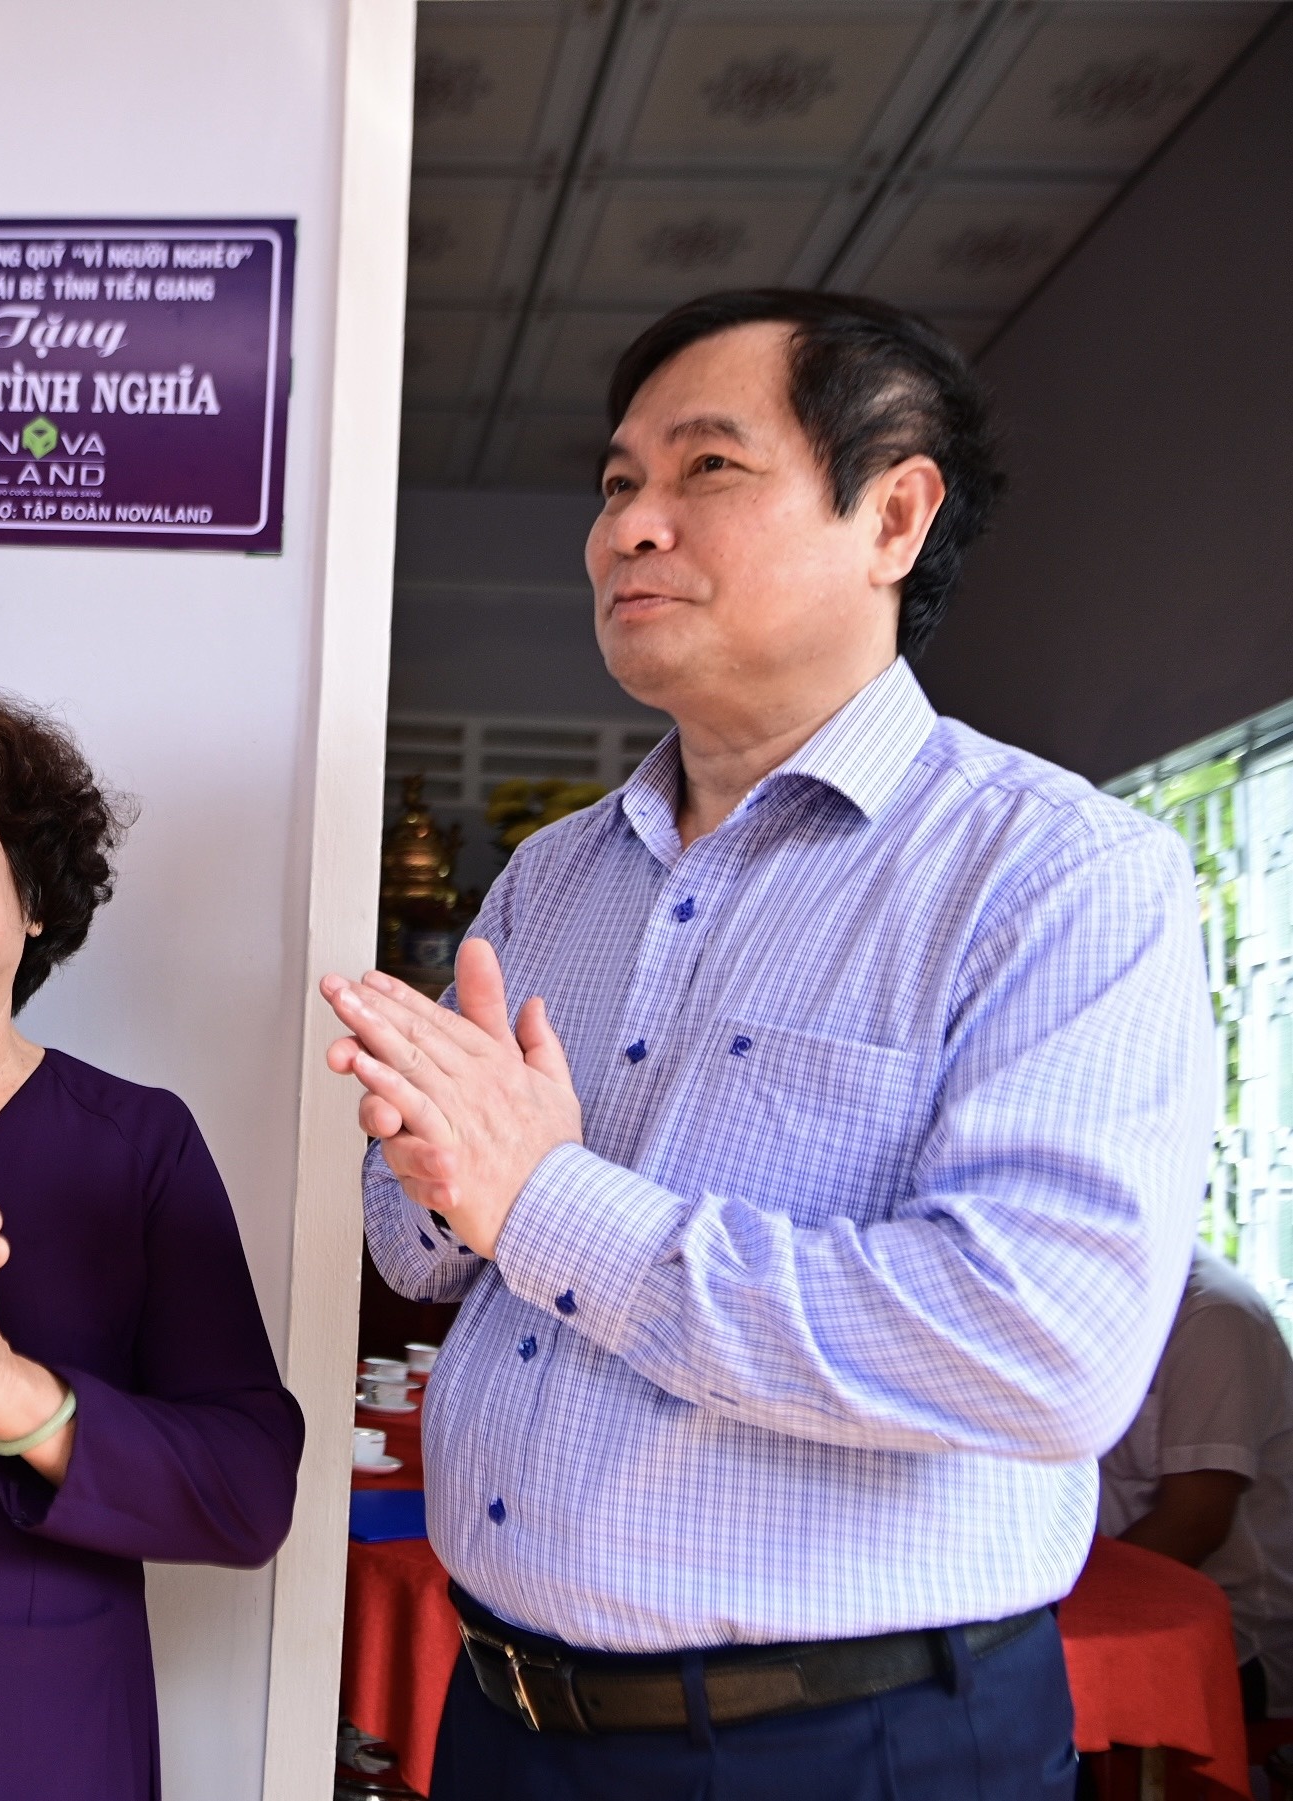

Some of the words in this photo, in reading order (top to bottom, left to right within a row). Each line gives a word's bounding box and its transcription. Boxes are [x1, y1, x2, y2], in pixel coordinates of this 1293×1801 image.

[25, 241, 66, 271] QUỸ
[108, 241, 169, 268] NGƯỜI
[19, 272, 47, 300] BÈ
[52, 270, 99, 300] TỈNH
[104, 269, 151, 300] TIỀN
[155, 275, 215, 301] GIANG
[91, 363, 220, 415] NGHĨA
[22, 501, 57, 522] TẬP
[61, 501, 111, 521] ĐOÀN
[115, 503, 213, 523] NOVALAND
